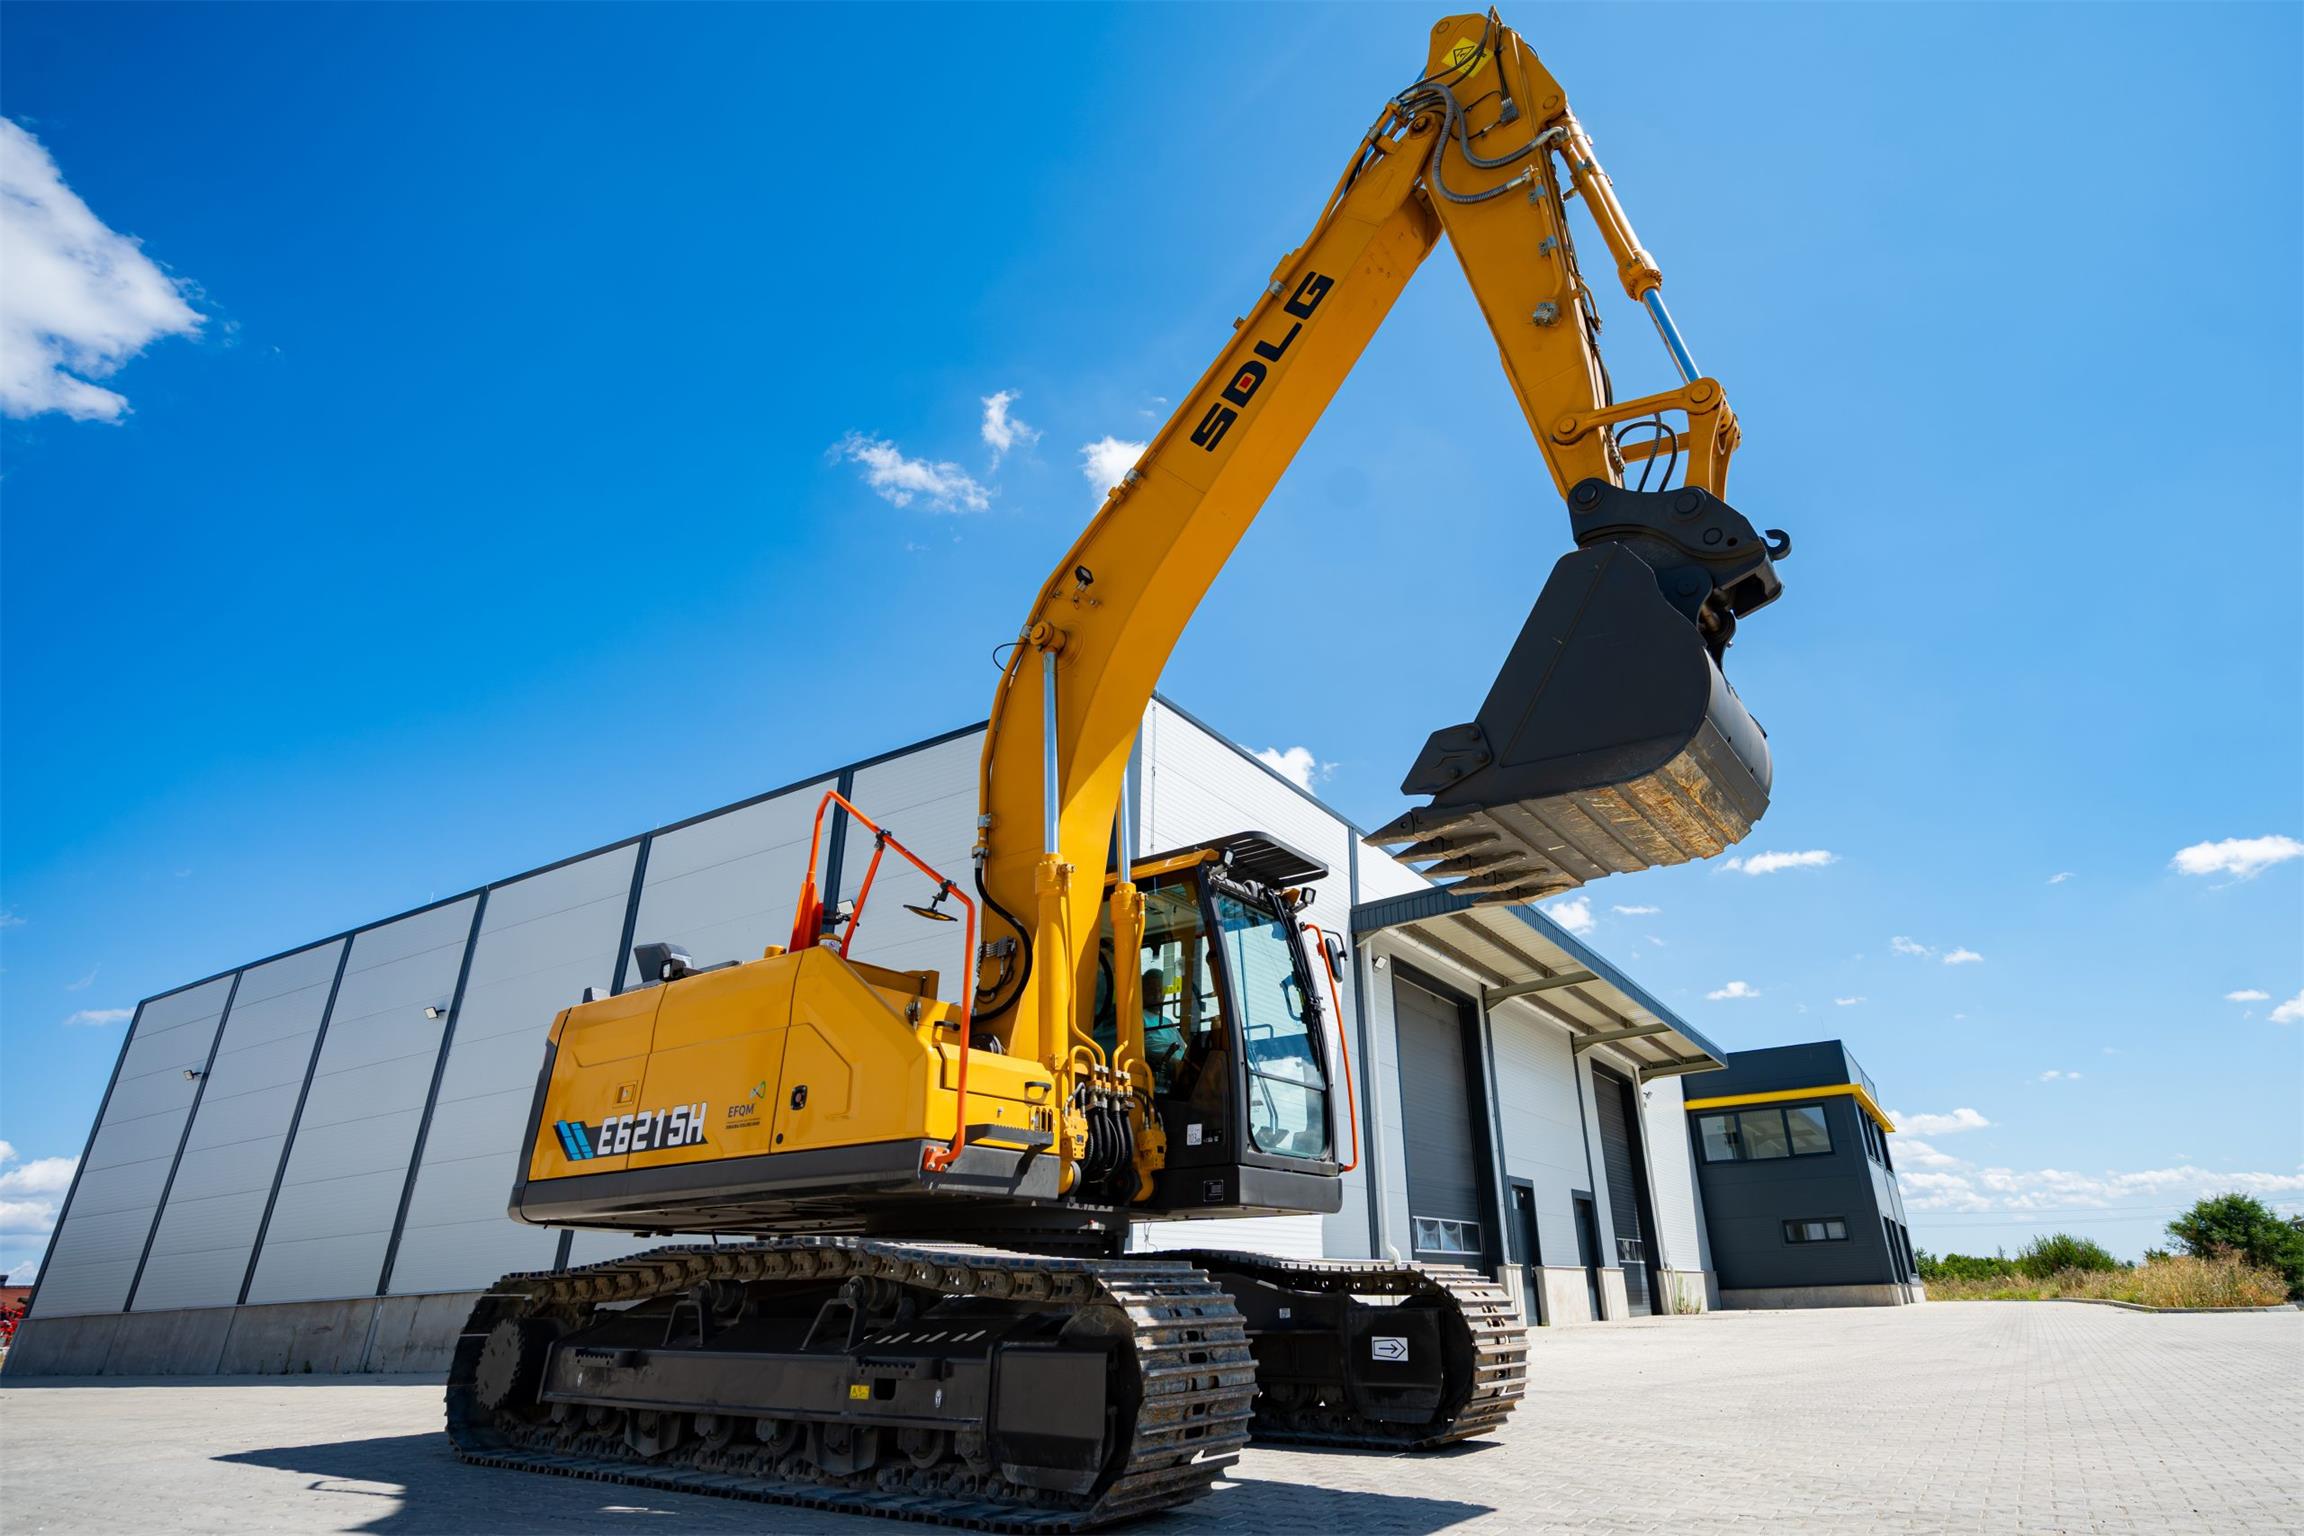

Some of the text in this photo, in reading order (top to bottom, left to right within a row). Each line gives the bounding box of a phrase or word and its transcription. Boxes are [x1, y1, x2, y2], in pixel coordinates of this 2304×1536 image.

[1190, 271, 1335, 452] SDLG
[597, 1102, 707, 1155] E6215H
[727, 1103, 755, 1118] EFQM
